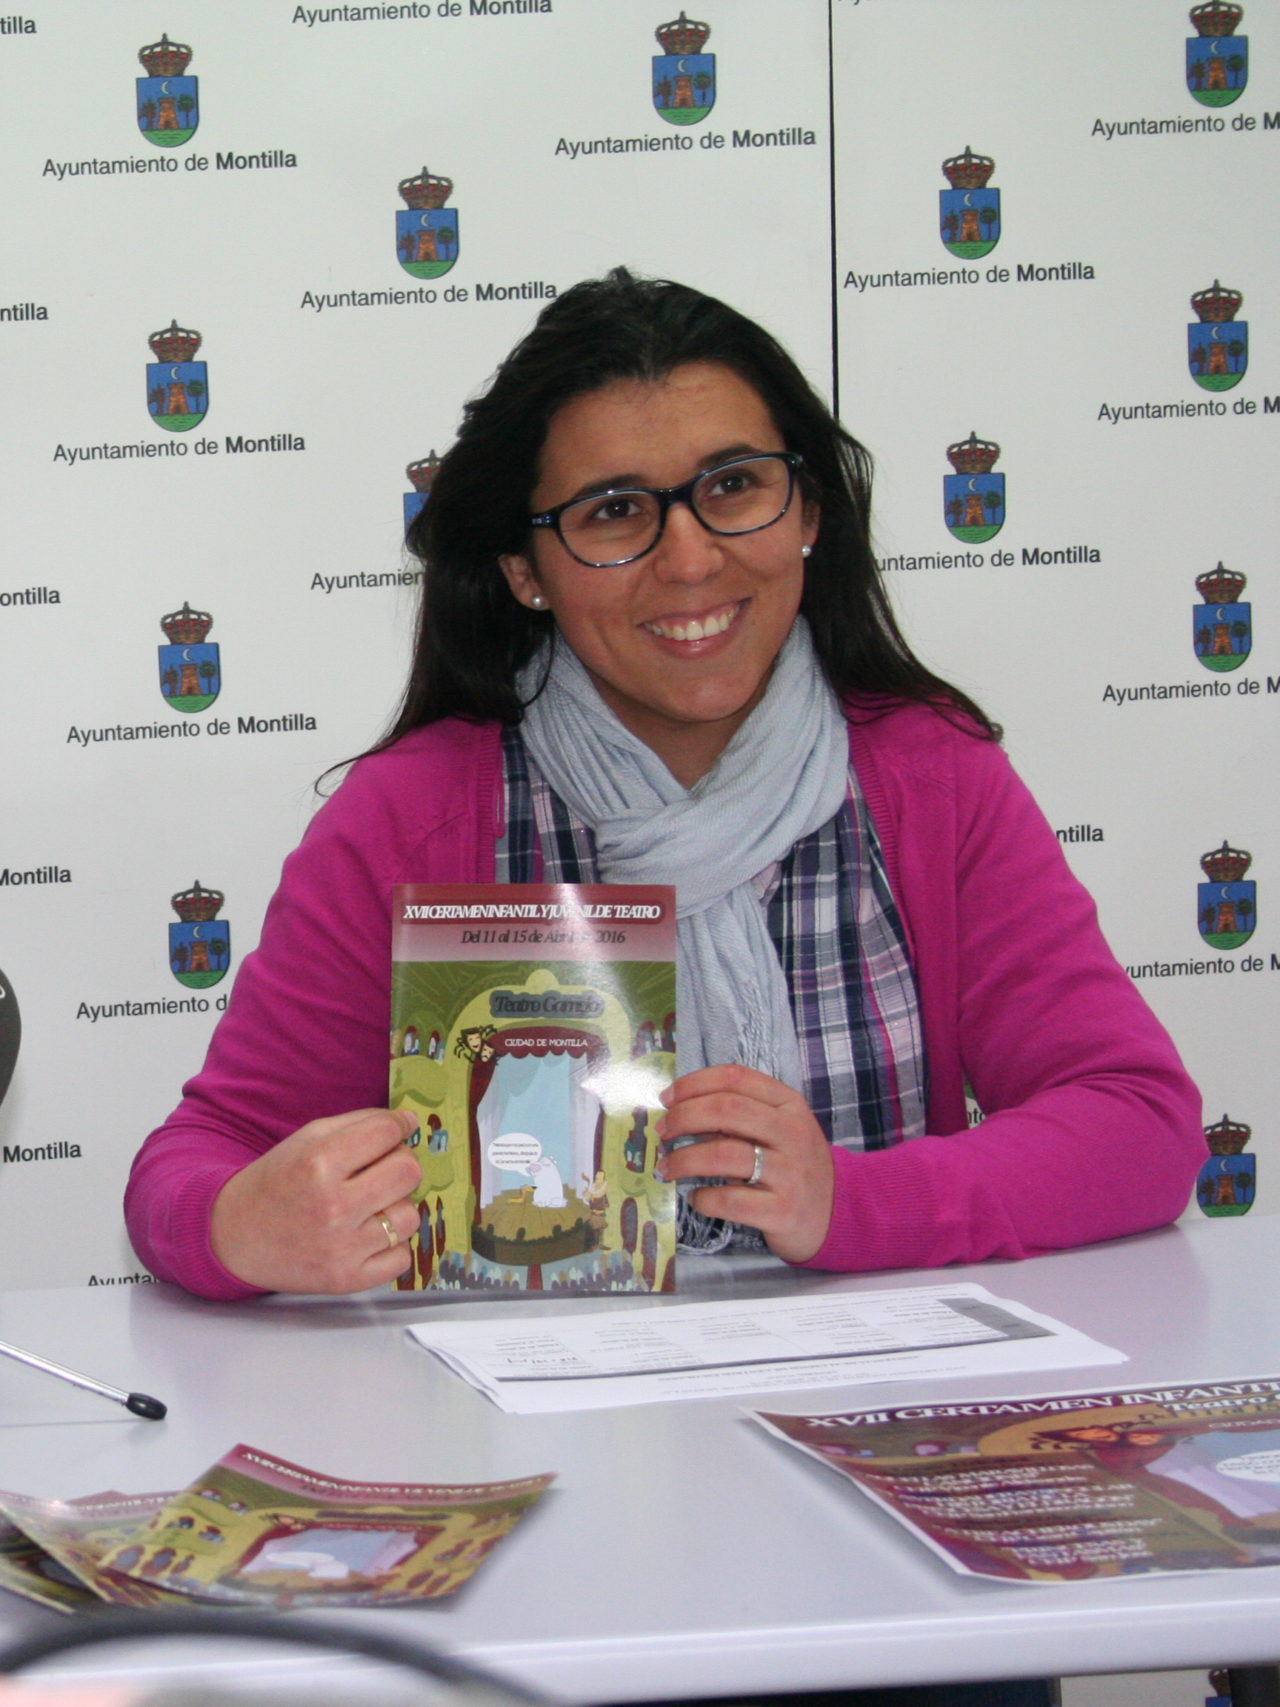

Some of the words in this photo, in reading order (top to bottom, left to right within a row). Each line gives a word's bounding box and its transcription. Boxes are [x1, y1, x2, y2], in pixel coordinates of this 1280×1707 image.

[291, 1, 431, 27] Ayuntamiento
[436, 0, 463, 18] de
[469, 0, 553, 17] Montilla
[1091, 115, 1226, 141] Ayuntamiento
[1231, 112, 1257, 132] de
[554, 133, 694, 160] Ayuntamiento
[699, 131, 726, 150] de
[732, 126, 817, 149] Montilla
[42, 155, 179, 181] Ayuntamiento
[184, 153, 209, 172] de
[215, 149, 298, 171] Montilla
[843, 267, 980, 293] Ayuntamiento
[985, 264, 1011, 284] de
[1016, 261, 1096, 283] Montilla
[300, 287, 438, 313] Ayuntamiento
[443, 284, 469, 303] de
[475, 280, 557, 302] Montilla
[1097, 399, 1228, 425] Ayuntamiento
[1232, 397, 1257, 416] de
[53, 439, 189, 466] Ayuntamiento
[193, 437, 219, 456] de
[225, 433, 306, 454] Montilla
[875, 551, 985, 575] untamiento
[990, 548, 1015, 568] de
[1021, 545, 1102, 566] Montilla
[1102, 679, 1232, 705] Ayuntamiento
[1236, 677, 1261, 696] de
[66, 719, 201, 747] Ayuntamiento
[206, 717, 231, 736] de
[237, 712, 318, 735] Montilla
[1056, 824, 1105, 843] ntilla
[613, 904, 661, 920] TEATRO
[461, 930, 480, 944] Del
[484, 930, 497, 944] 11
[498, 930, 511, 944] al
[513, 930, 527, 944] 15
[528, 930, 544, 944] de
[595, 930, 626, 944] 2016
[1126, 957, 1236, 979] untamiento
[1240, 954, 1264, 973] de
[76, 995, 210, 1023] Ayuntamiento
[215, 993, 231, 1011] d
[504, 1038, 535, 1047] CIUDAD
[536, 1038, 547, 1047] DE
[549, 1038, 588, 1047] MONTILLA
[2, 1140, 83, 1164] Montilla
[806, 1412, 891, 1427] XVII
[895, 1395, 1114, 1419] CERTAMEN
[1118, 1382, 1280, 1405] INFANTI
[1162, 1396, 1268, 1411] Teatro
